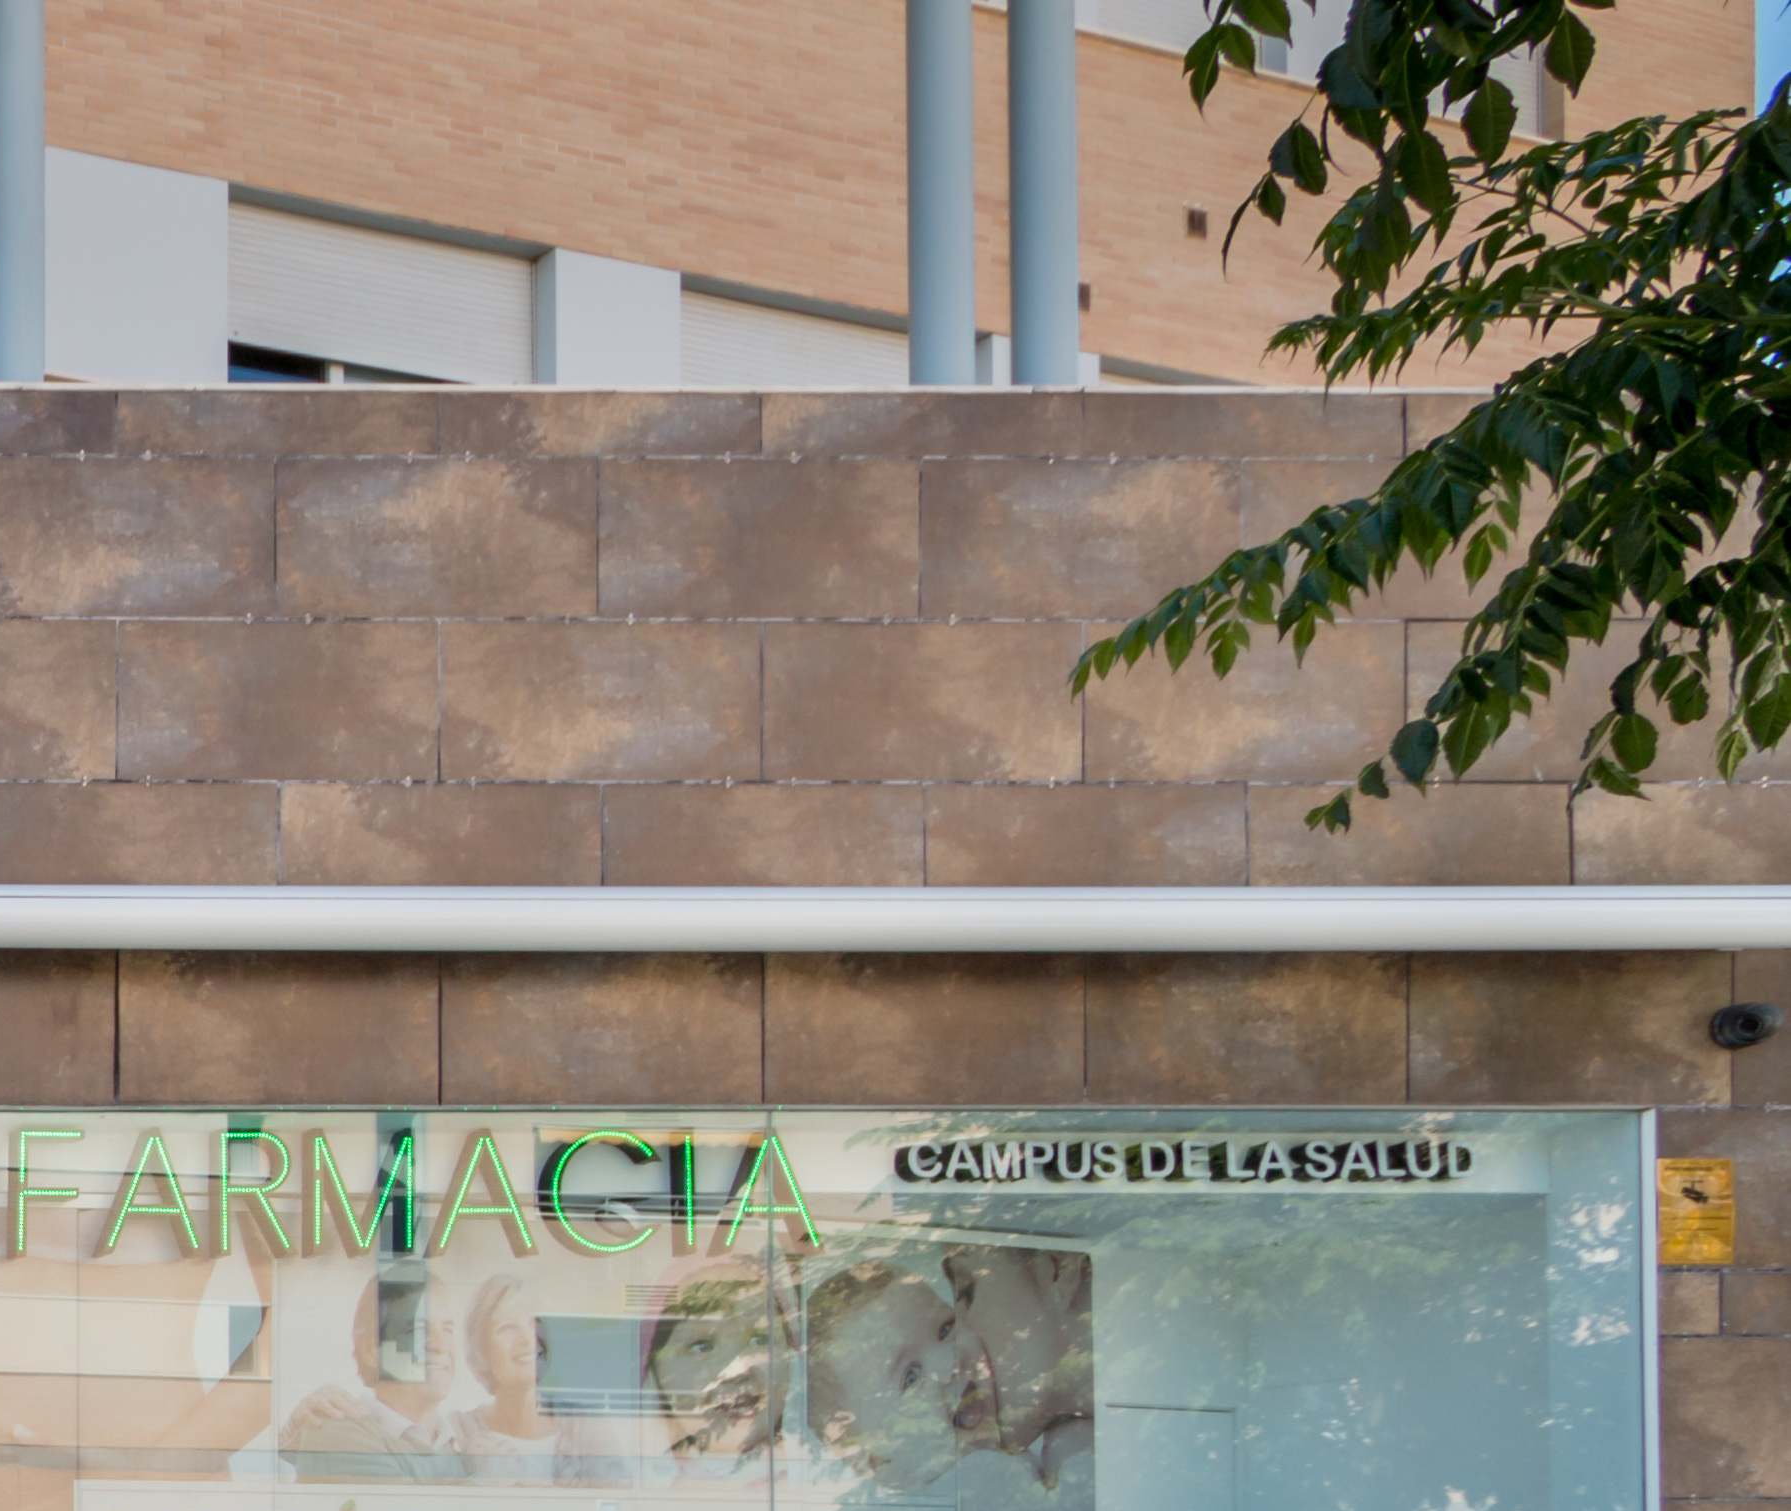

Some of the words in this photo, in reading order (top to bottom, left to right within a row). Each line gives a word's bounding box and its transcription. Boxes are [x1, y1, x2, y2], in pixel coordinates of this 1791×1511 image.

[14, 1128, 820, 1253] FARMACIA
[905, 1140, 1123, 1180] CAMPUS
[1142, 1140, 1211, 1179] DE
[1227, 1140, 1294, 1179] LA
[1305, 1140, 1476, 1179] SALUD
